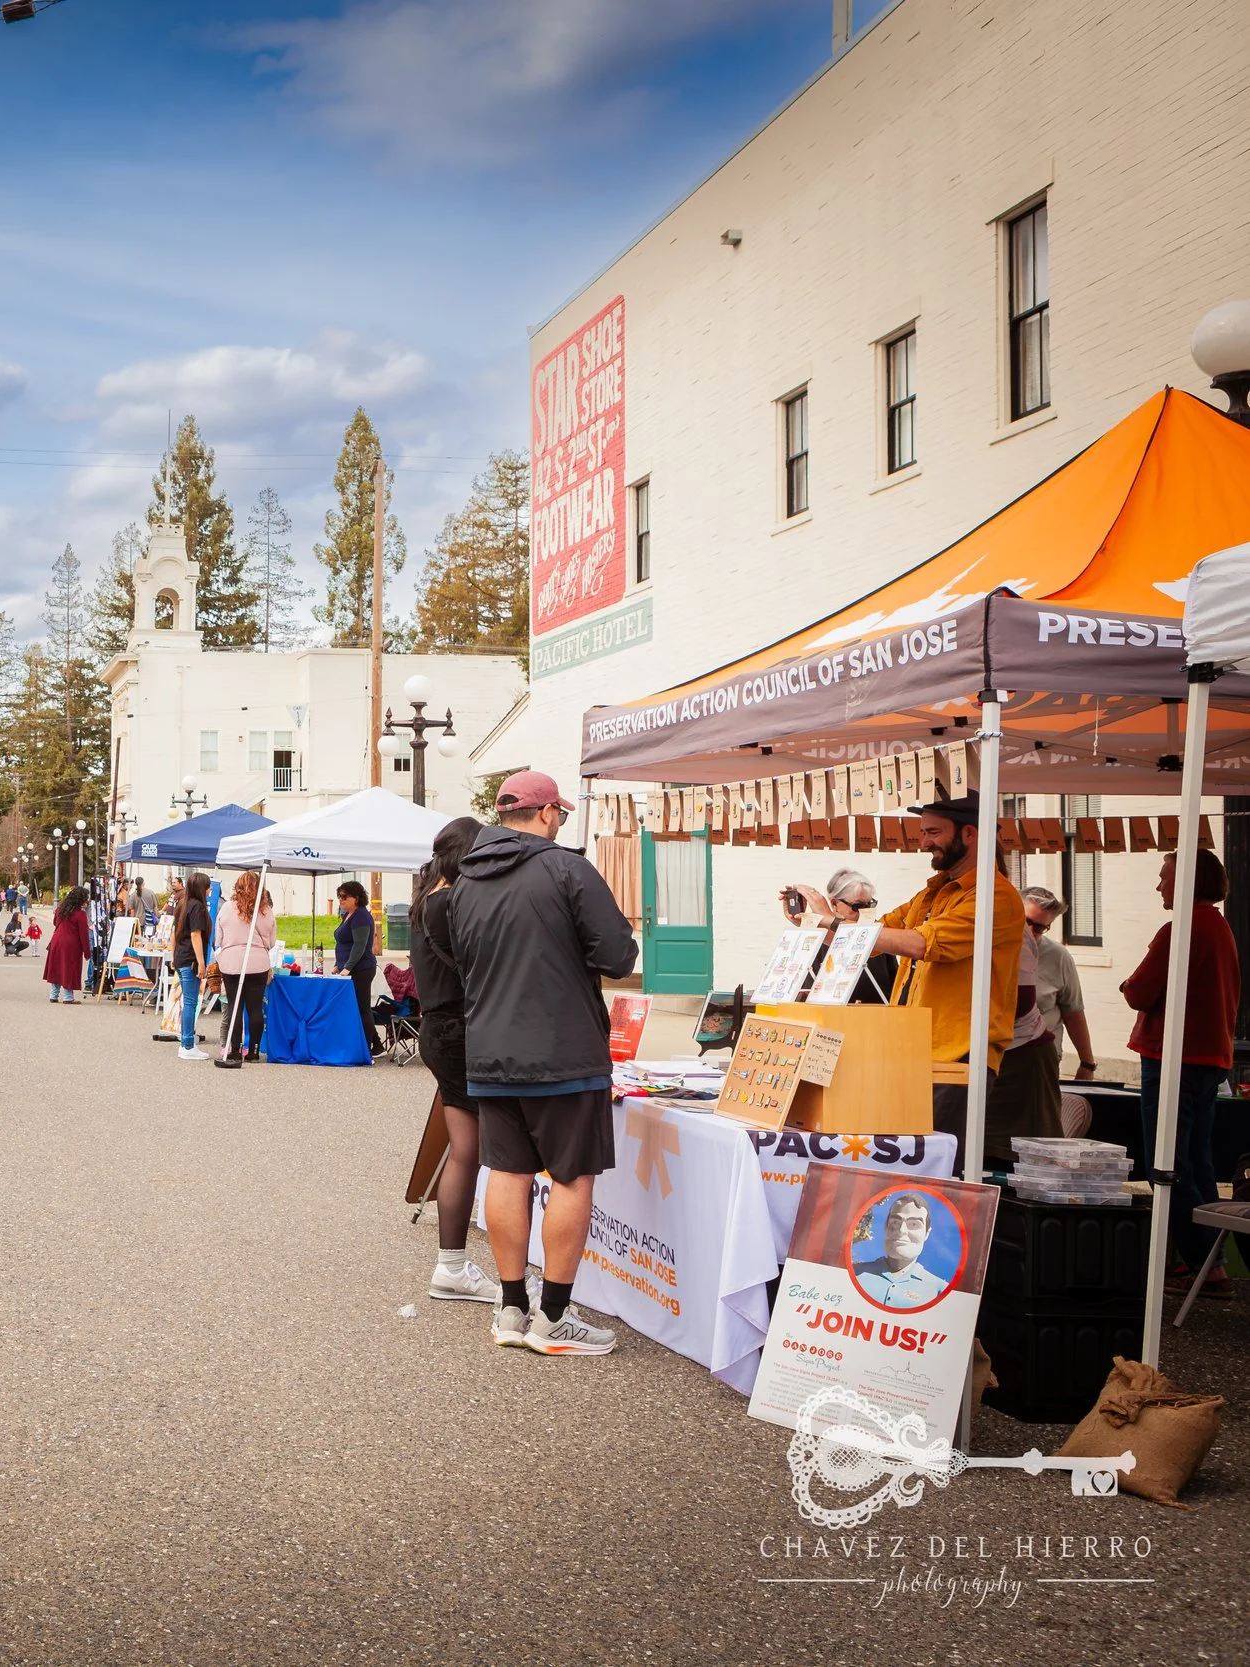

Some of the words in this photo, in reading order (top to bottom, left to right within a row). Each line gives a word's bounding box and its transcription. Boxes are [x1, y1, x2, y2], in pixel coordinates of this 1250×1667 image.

[582, 303, 622, 378] SHOE
[535, 342, 580, 458] STAR
[581, 357, 622, 424] STORE
[534, 454, 552, 504] 42
[534, 467, 615, 567] FOOTWEAR
[533, 628, 590, 674] PACIFIC
[592, 608, 648, 653] HOTEL
[589, 701, 678, 744] PRESERVATION
[680, 685, 739, 722] ACTION
[742, 663, 817, 706] COUNCIL
[818, 654, 844, 686] OF
[849, 639, 893, 678] SAN
[898, 619, 958, 665] JOSE
[590, 1222, 613, 1252] UNCIL
[615, 1240, 628, 1258] OF
[630, 1248, 652, 1272] SAN
[654, 1260, 677, 1287] JOSE
[642, 1233, 675, 1265] ACTION
[788, 1284, 820, 1301] Babe
[824, 1293, 844, 1306] sez
[782, 1339, 808, 1353] SAN
[809, 1345, 844, 1361] JOSE
